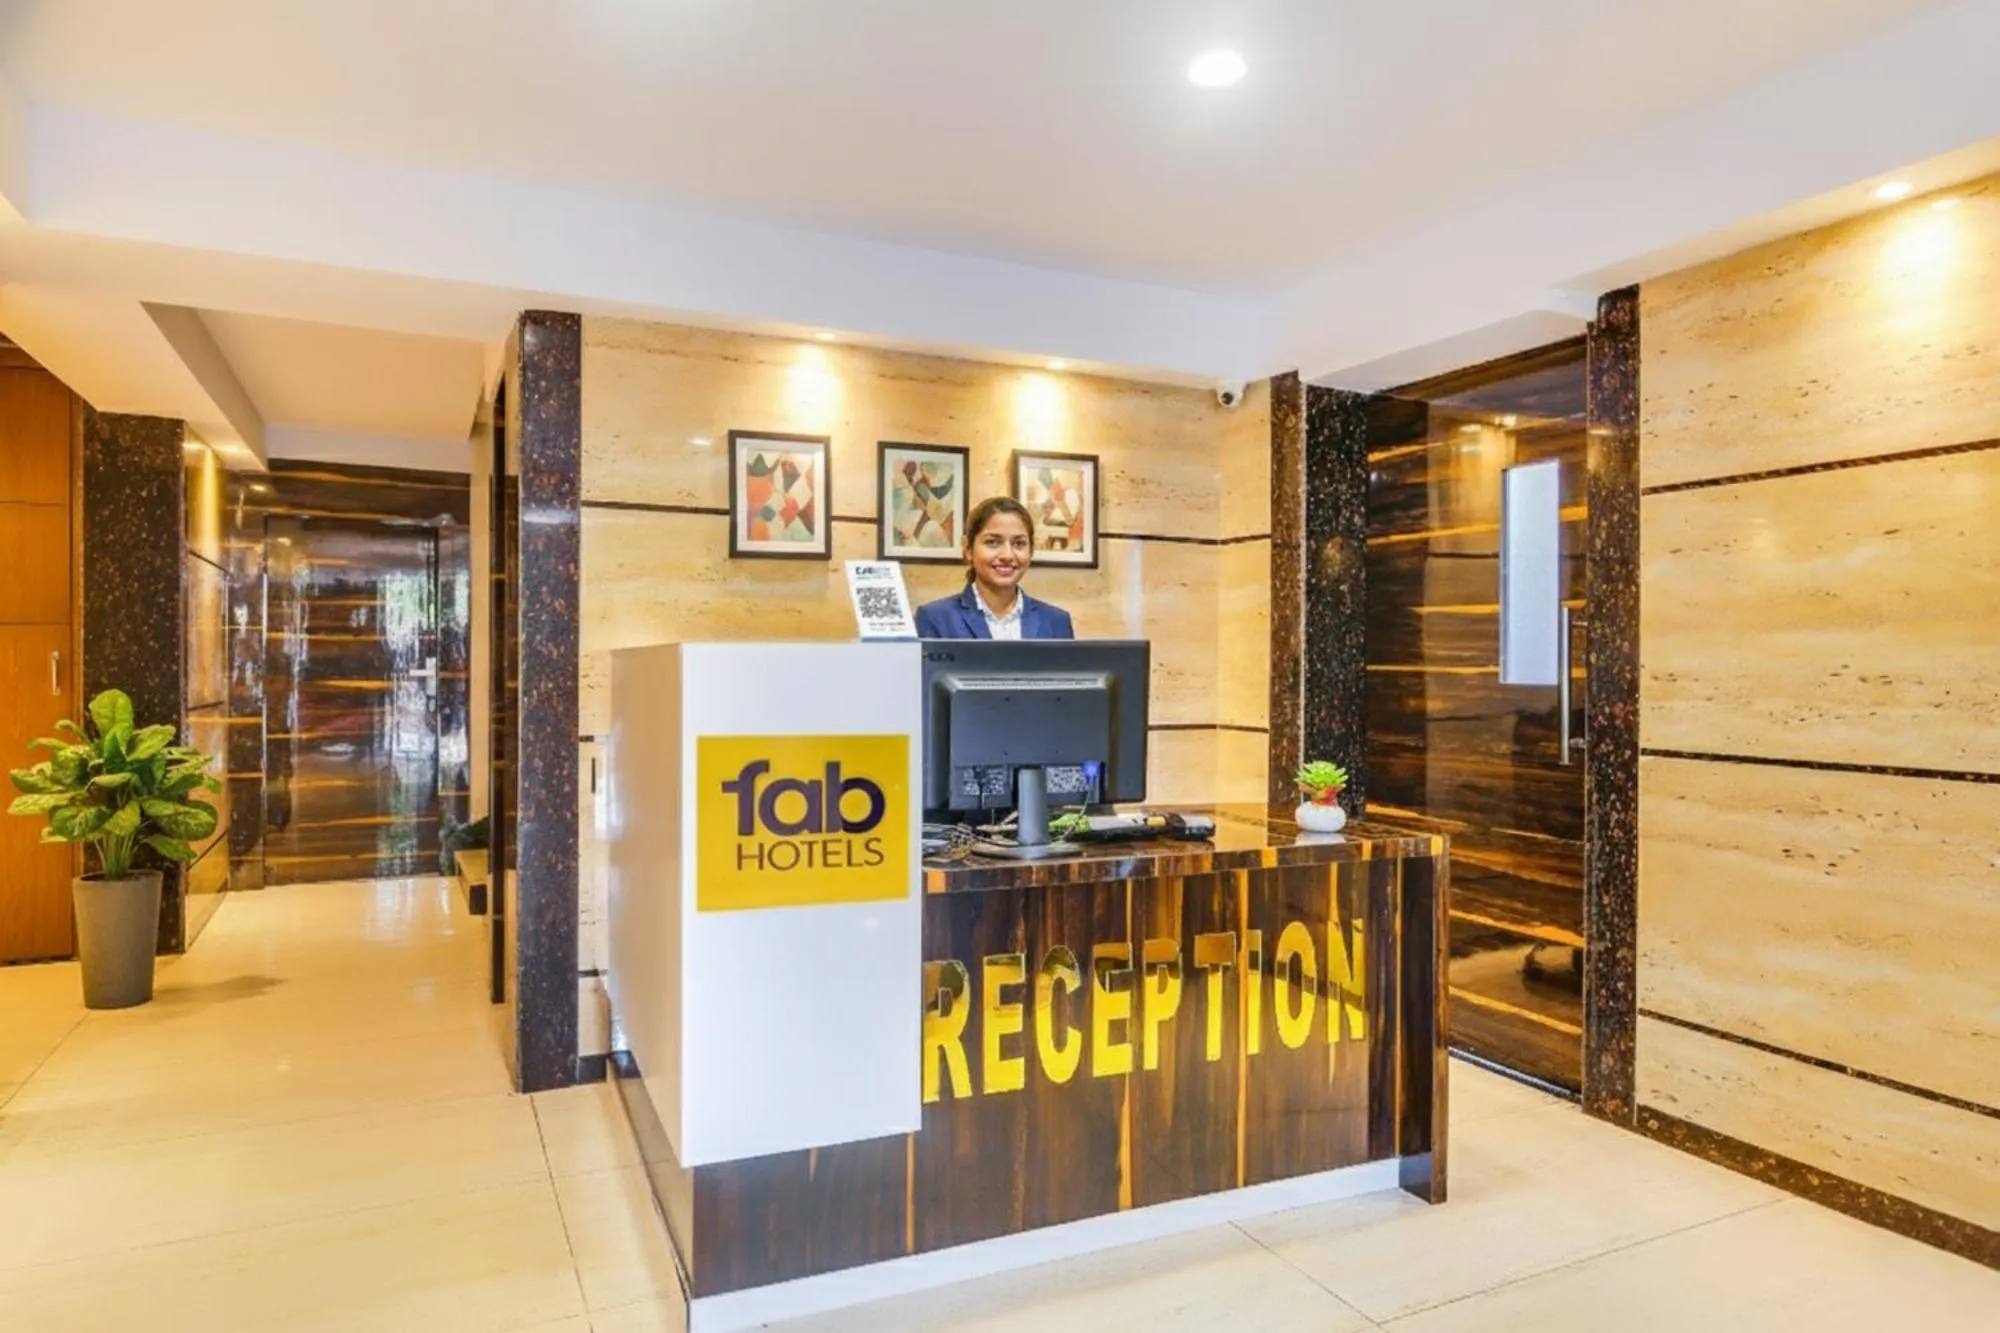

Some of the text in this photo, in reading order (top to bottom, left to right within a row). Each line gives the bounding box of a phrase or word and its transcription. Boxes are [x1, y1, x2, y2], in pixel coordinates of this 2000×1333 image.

[721, 759, 886, 836] fab
[736, 837, 885, 872] HOTELS
[922, 917, 1366, 1104] RECEPTION
